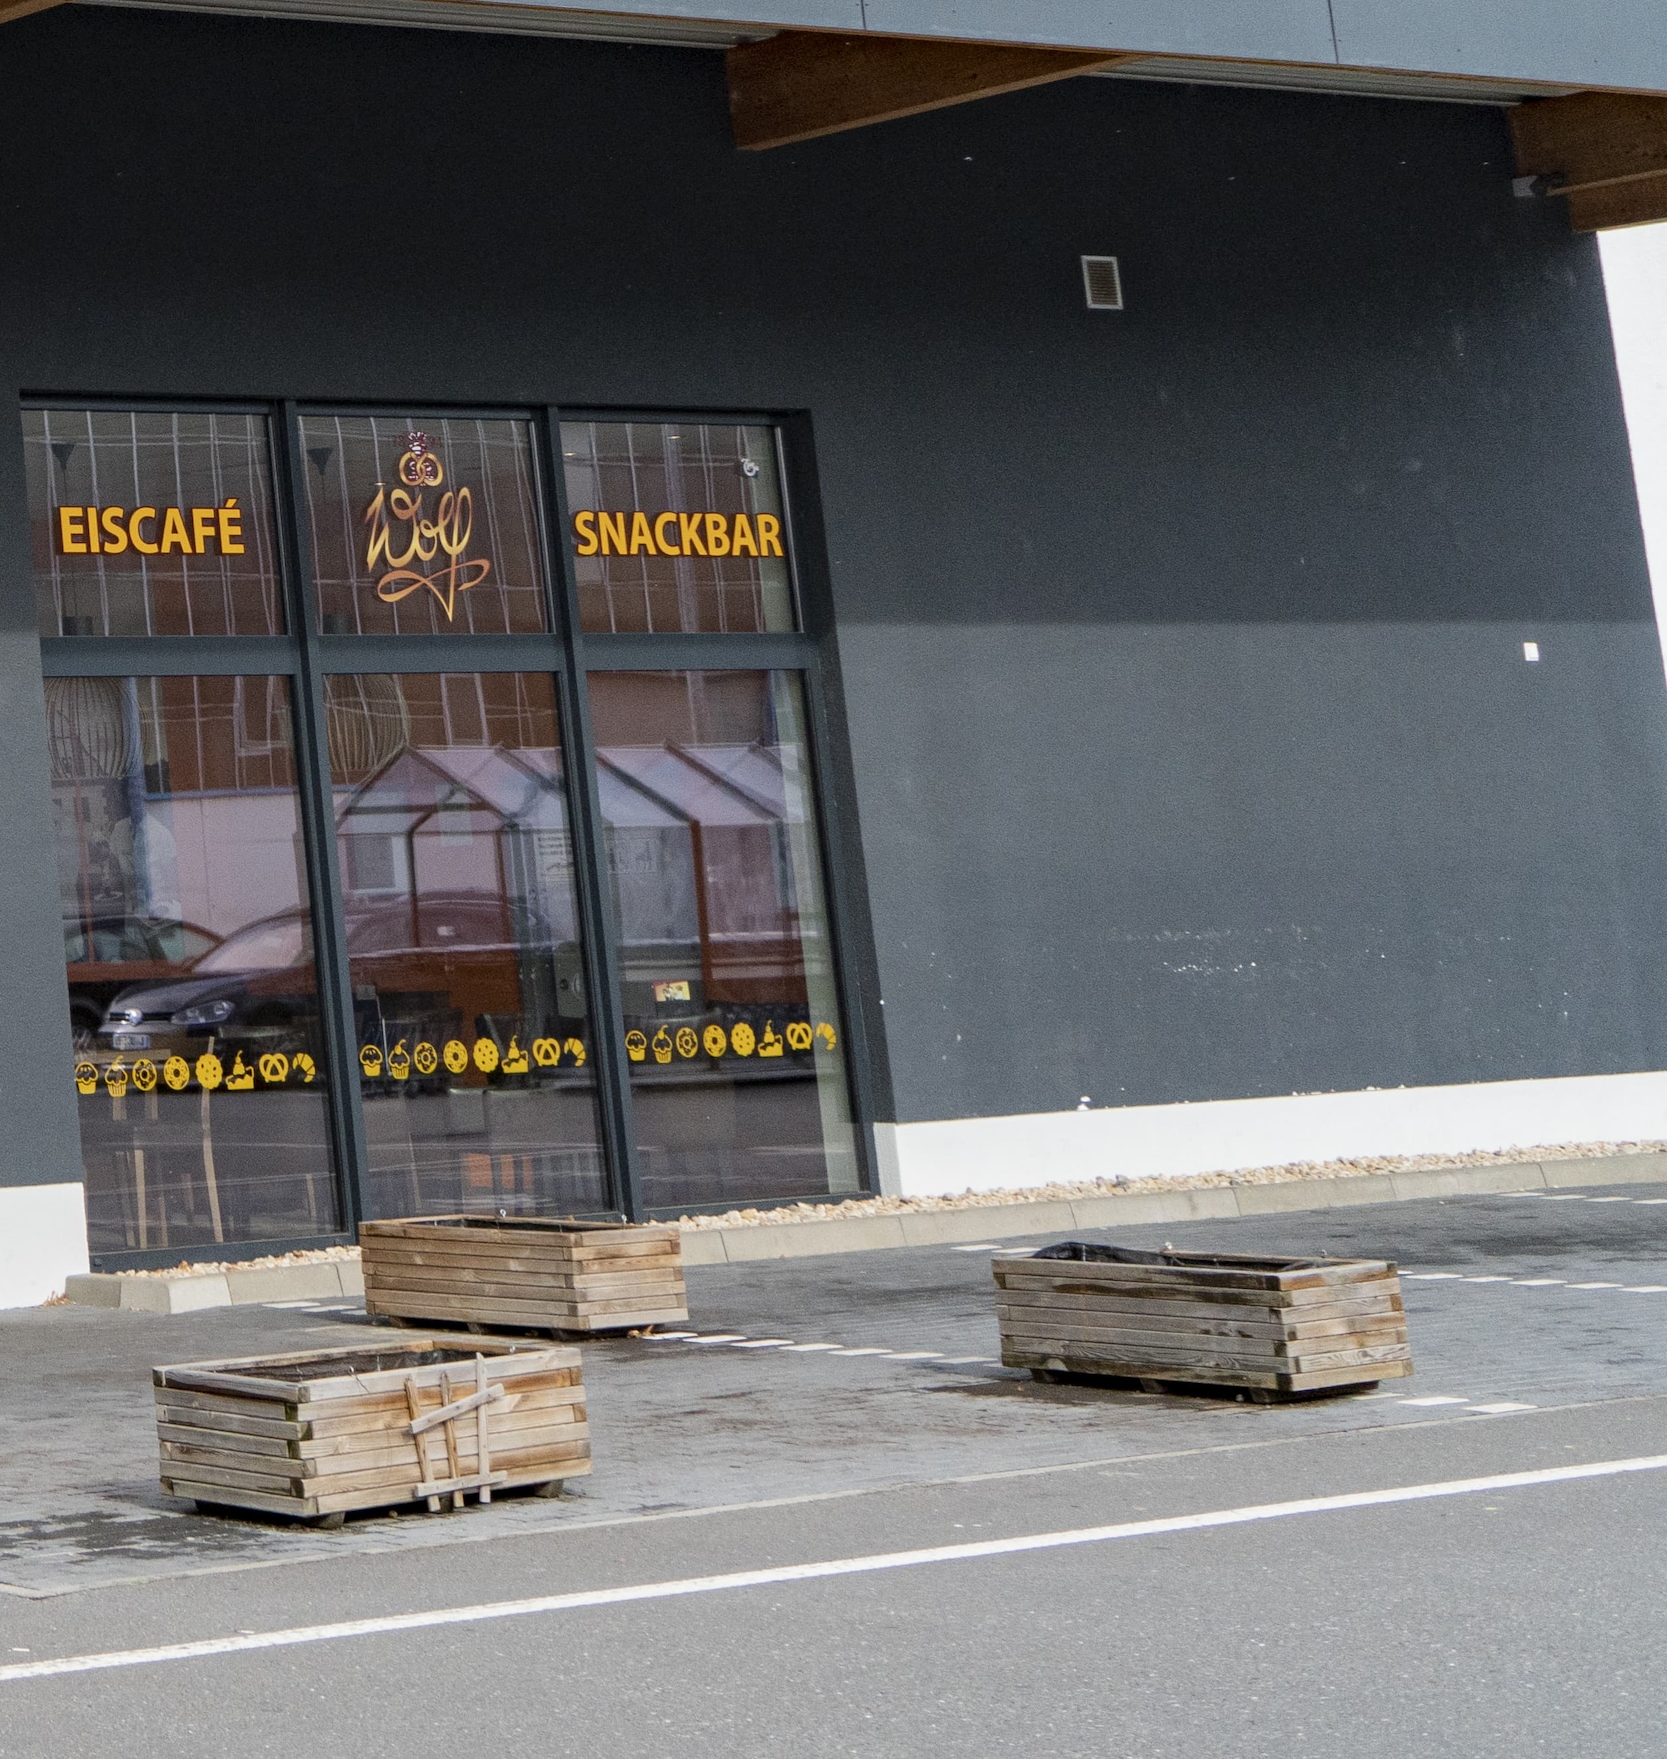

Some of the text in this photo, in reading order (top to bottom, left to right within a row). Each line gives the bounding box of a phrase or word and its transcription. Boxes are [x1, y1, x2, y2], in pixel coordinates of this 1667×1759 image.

[58, 497, 246, 557] EISCAFÉ
[365, 486, 491, 622] Wolf
[573, 509, 785, 558] SNACKBAR
